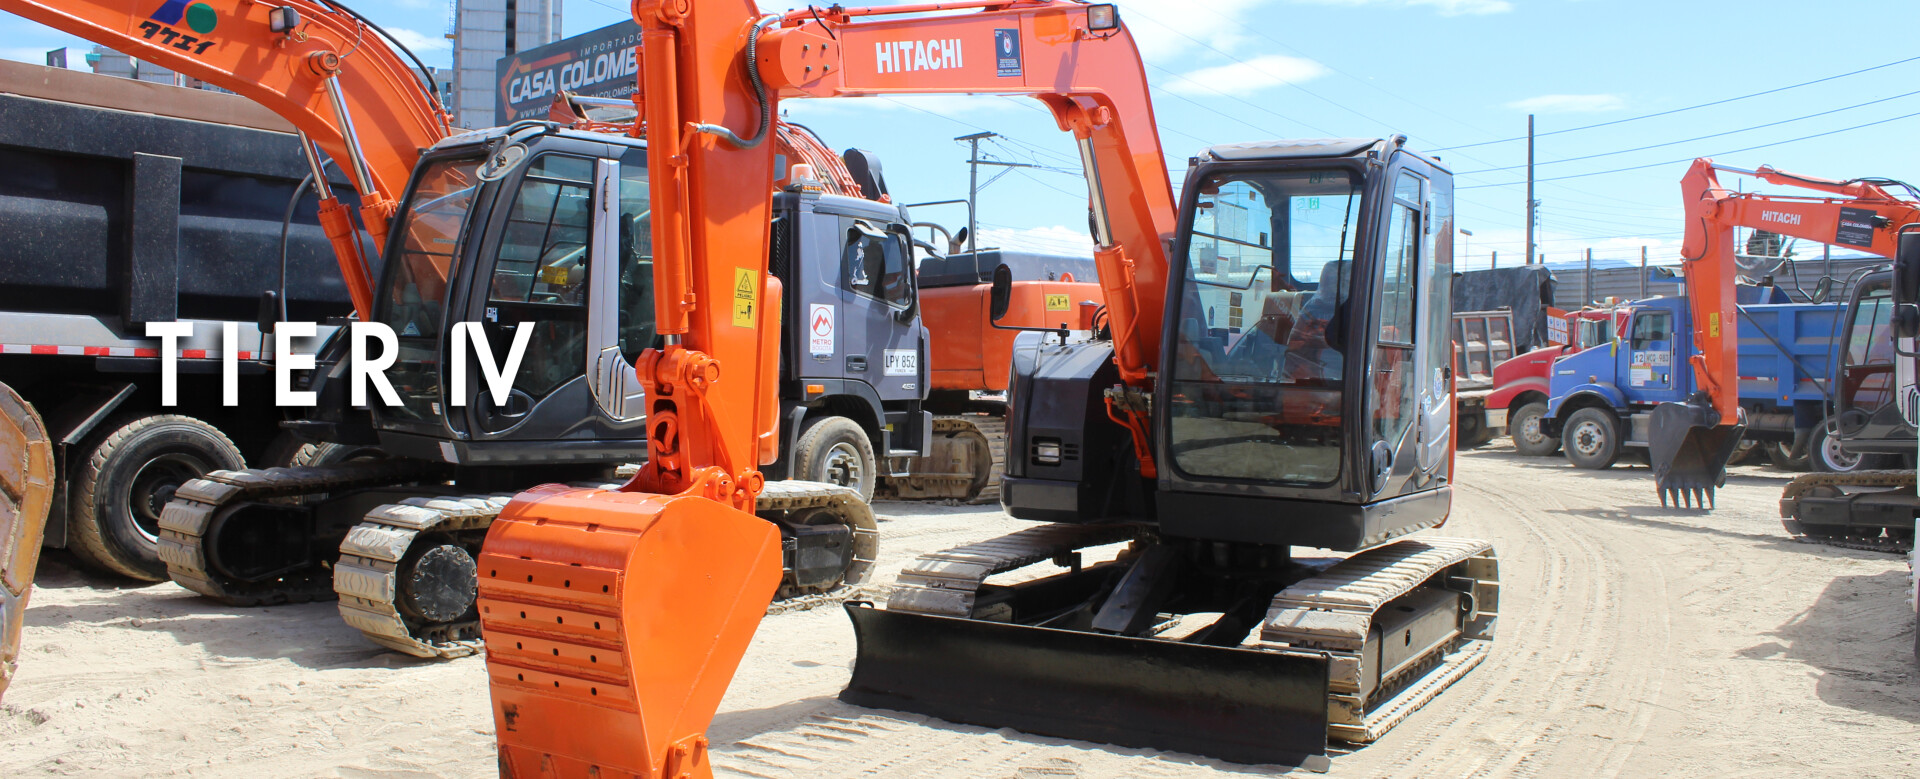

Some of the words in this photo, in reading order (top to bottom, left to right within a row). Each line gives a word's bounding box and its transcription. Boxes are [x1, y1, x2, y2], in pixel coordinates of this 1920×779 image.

[139, 20, 216, 55] タケエイ
[875, 38, 963, 73] HITACHI
[510, 69, 555, 104] CASA
[1761, 210, 1801, 226] HITACHI
[885, 355, 900, 368] LPY
[901, 355, 915, 368] 852
[1634, 354, 1644, 363] 12
